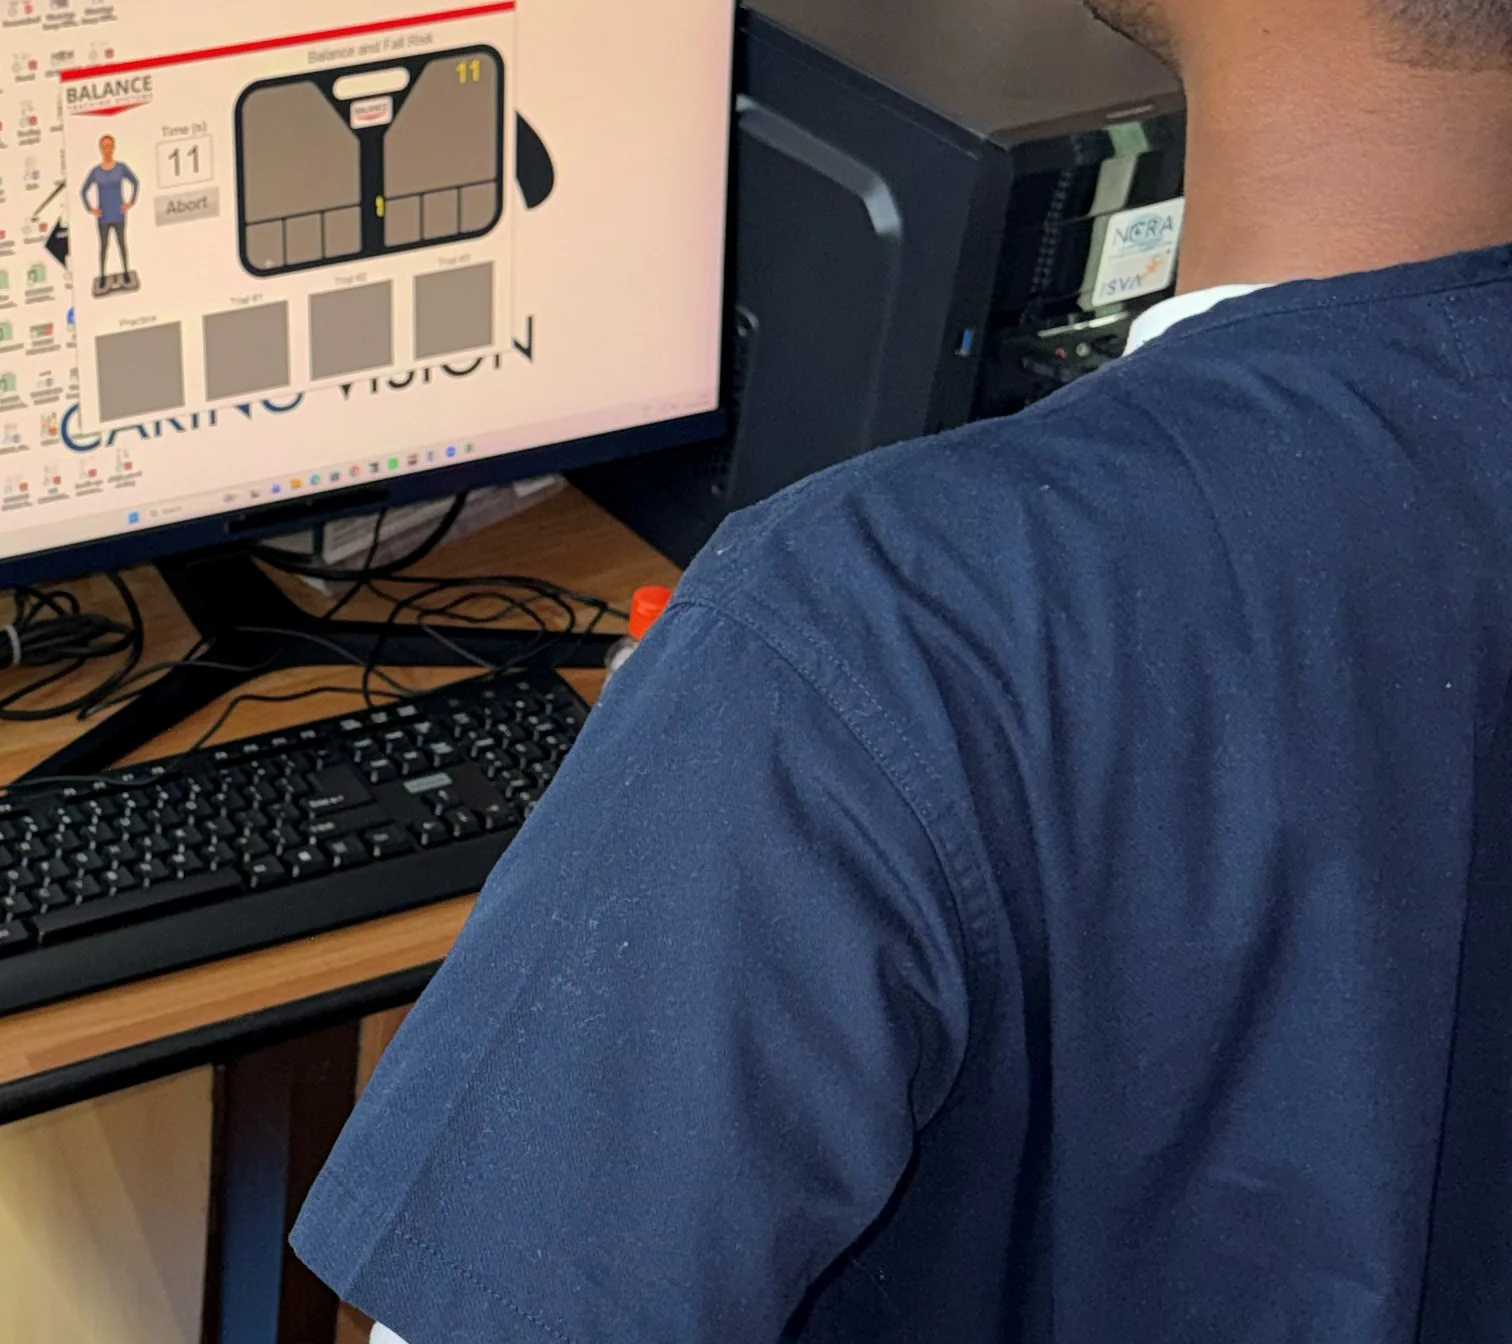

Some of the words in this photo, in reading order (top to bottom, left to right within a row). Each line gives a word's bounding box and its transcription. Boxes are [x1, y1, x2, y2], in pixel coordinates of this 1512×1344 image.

[307, 46, 355, 64] Balance
[358, 41, 381, 55] and
[383, 37, 406, 51] Fall
[407, 34, 433, 47] Risk
[456, 59, 480, 84] 11
[66, 74, 153, 104] BALANCE
[161, 123, 189, 138] Time
[168, 145, 200, 177] 11
[166, 195, 208, 216] Abort
